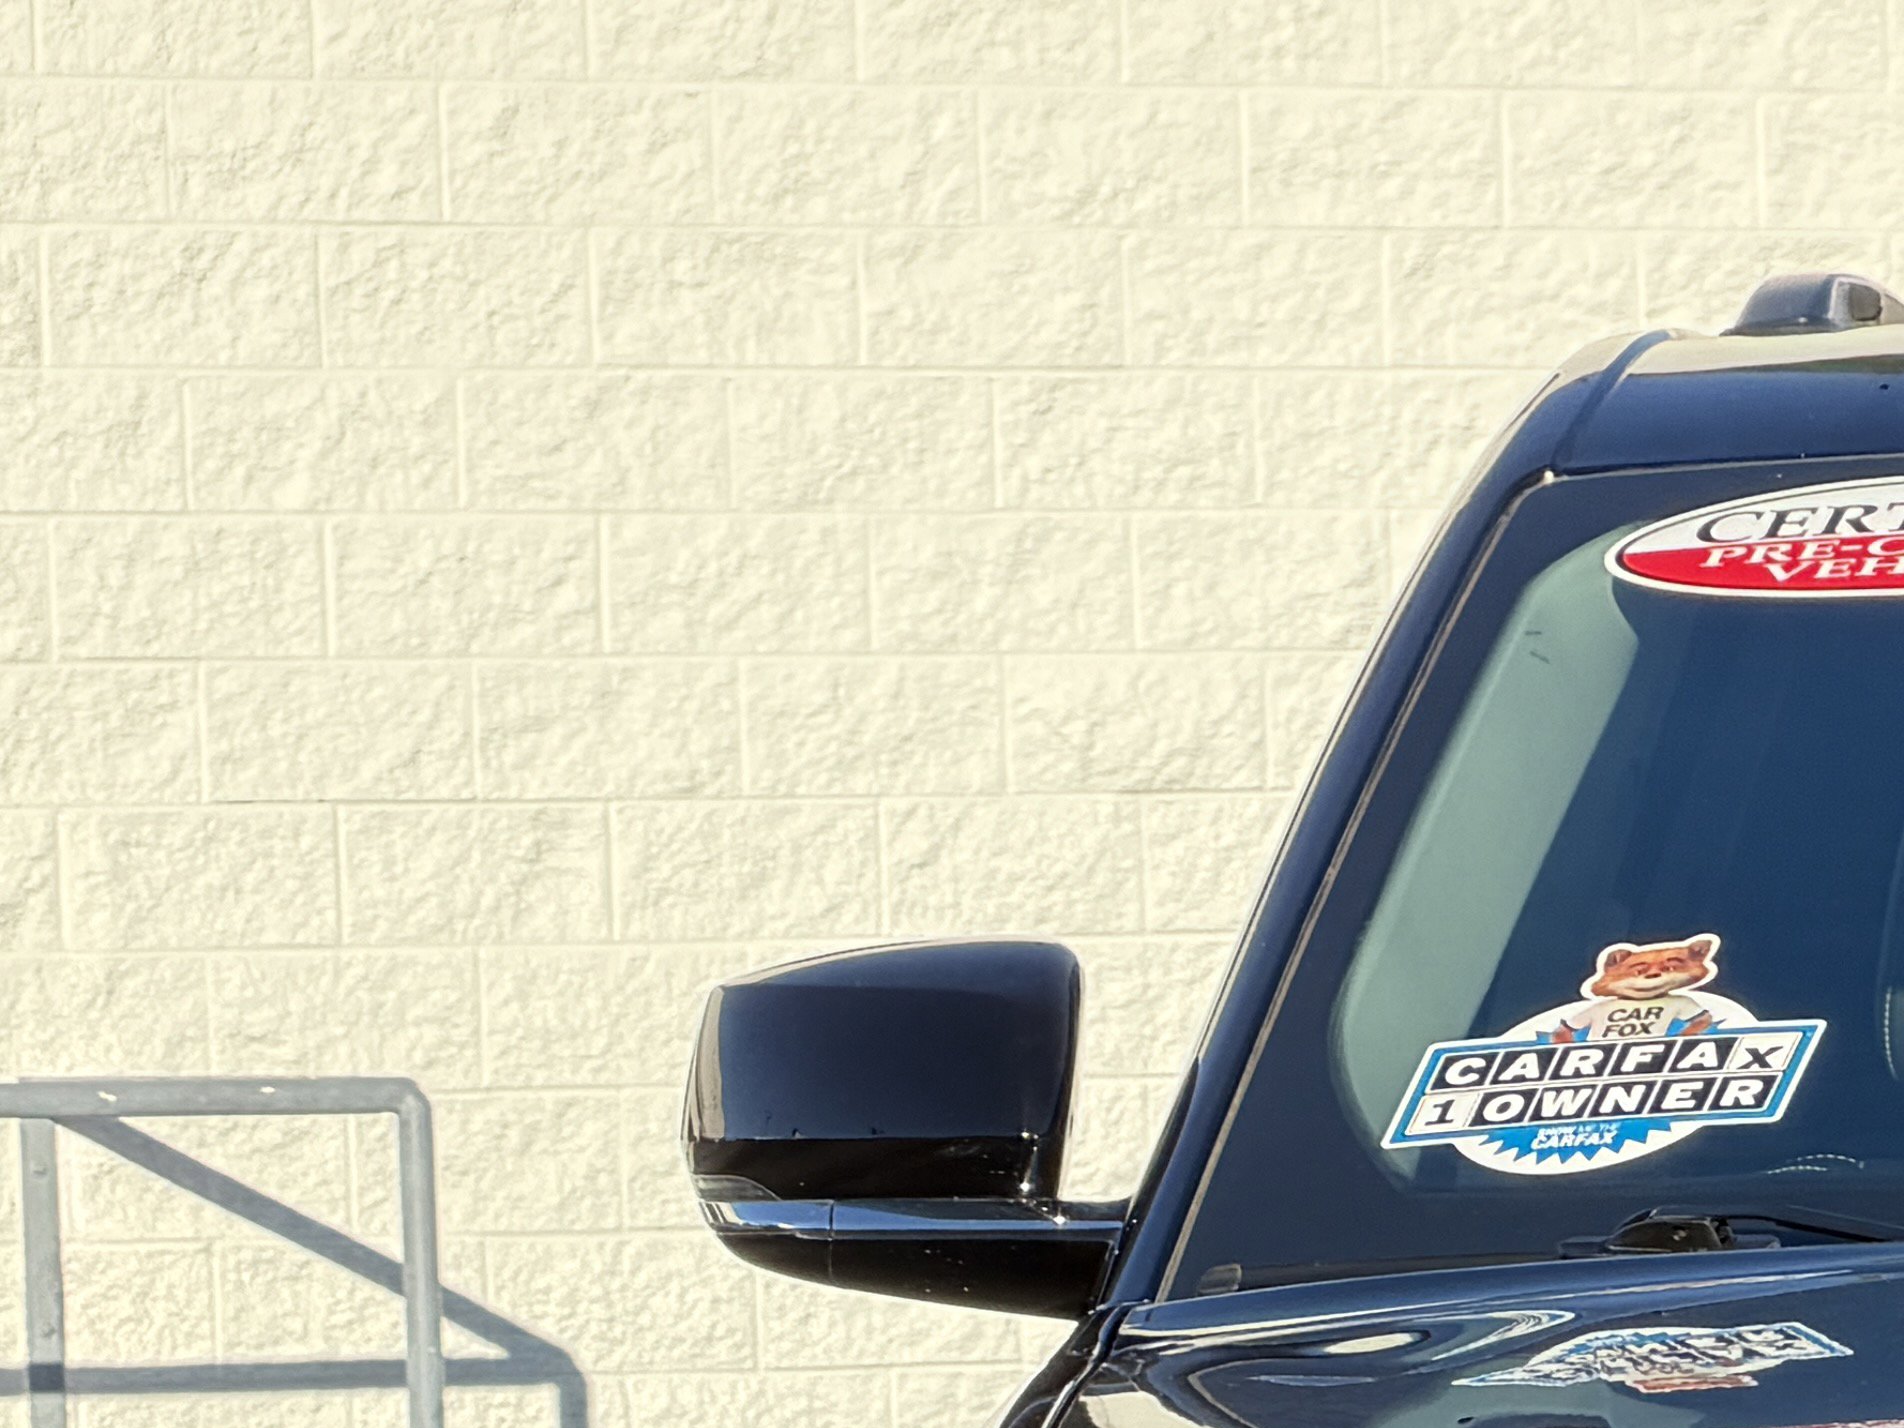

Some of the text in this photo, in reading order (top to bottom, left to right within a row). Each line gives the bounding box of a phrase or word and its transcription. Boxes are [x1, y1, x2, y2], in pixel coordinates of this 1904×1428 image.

[1601, 1021, 1653, 1038] FOX
[1607, 1005, 1664, 1024] CAR
[1444, 1042, 1784, 1086] CARFAX
[1424, 1079, 1765, 1126] 1 OWNER
